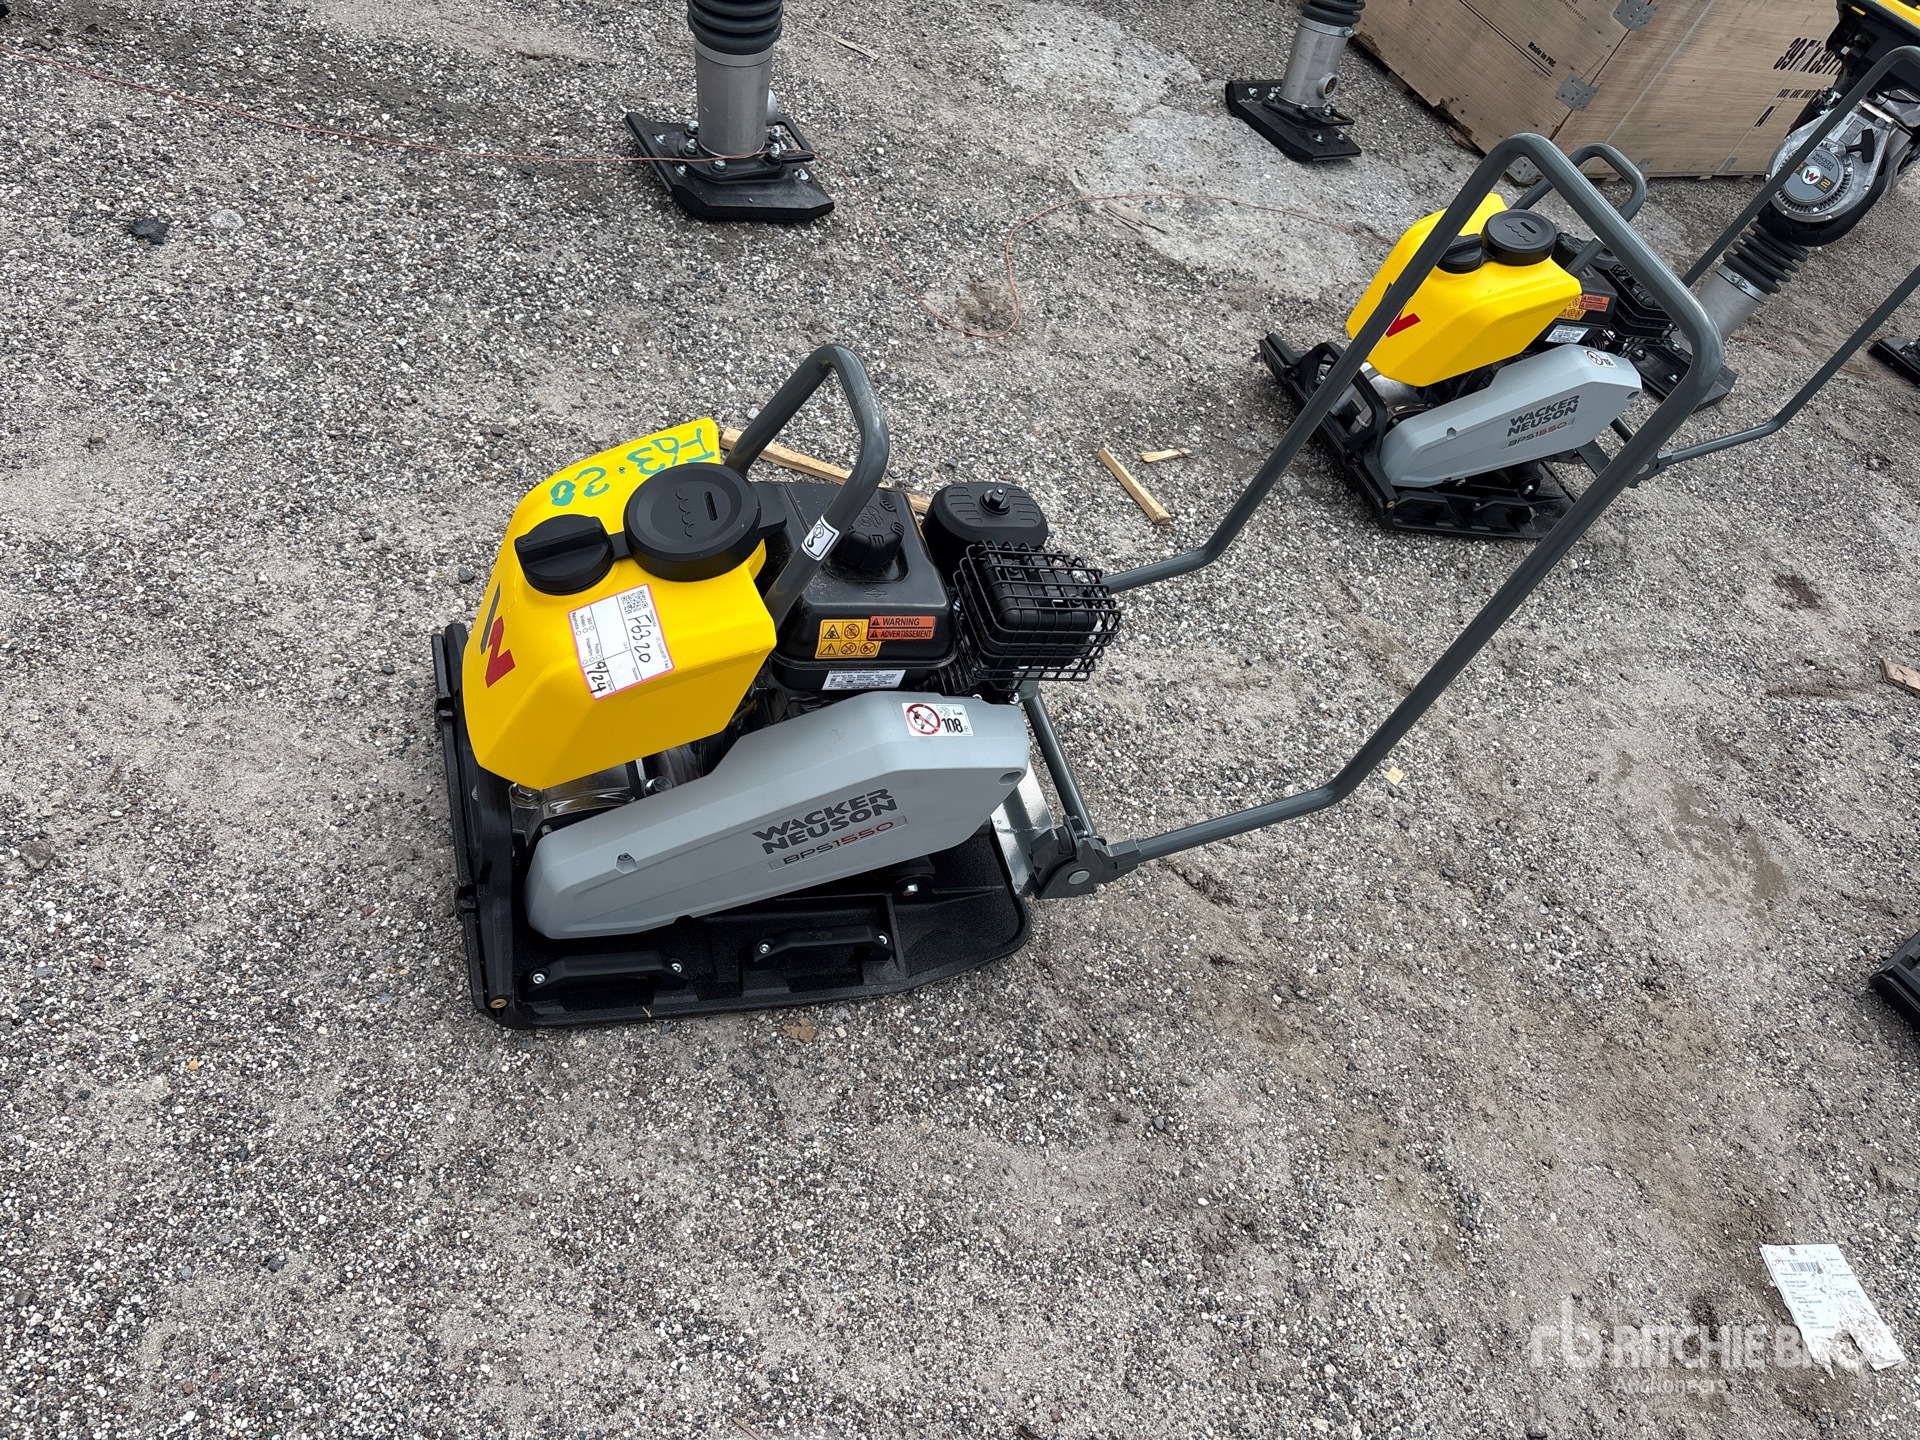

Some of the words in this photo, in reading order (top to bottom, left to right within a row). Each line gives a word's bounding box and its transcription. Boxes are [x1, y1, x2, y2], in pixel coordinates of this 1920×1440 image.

[1507, 404, 1579, 438] NEUSON
[1510, 394, 1580, 426] WACKER
[1509, 420, 1567, 447] BPS1550
[880, 629, 932, 639] ADVERTISSEMENT
[882, 617, 920, 626] WARNING
[627, 614, 651, 663] F63.20
[941, 717, 963, 733] 108
[752, 788, 894, 841] WACKER
[761, 798, 898, 855] NEUSON
[783, 820, 894, 865] BPS1550
